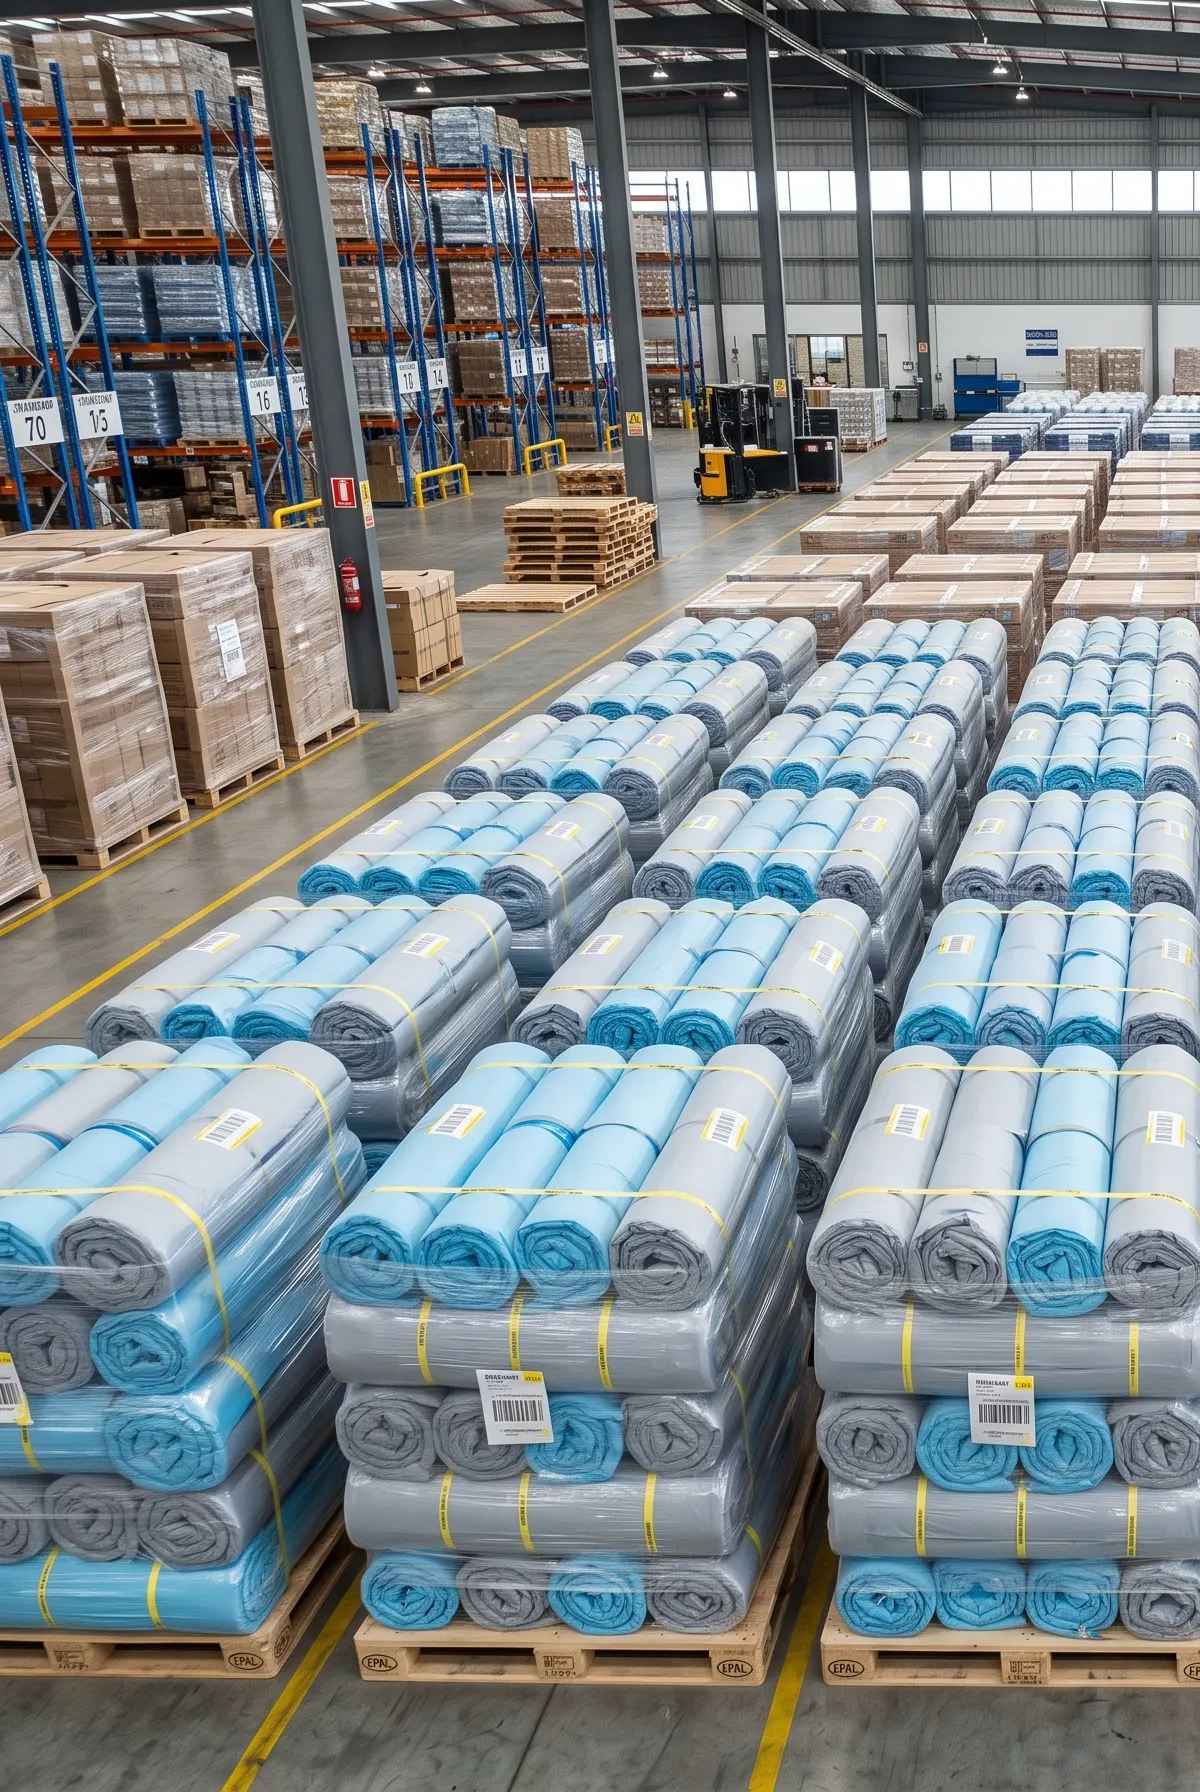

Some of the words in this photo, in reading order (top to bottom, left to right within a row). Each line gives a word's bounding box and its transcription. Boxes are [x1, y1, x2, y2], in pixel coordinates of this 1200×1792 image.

[256, 390, 270, 411] 16
[25, 415, 46, 441] 70
[233, 1656, 258, 1666] EPAL
[722, 1663, 747, 1673] EPAL
[833, 1663, 859, 1673] EPAL
